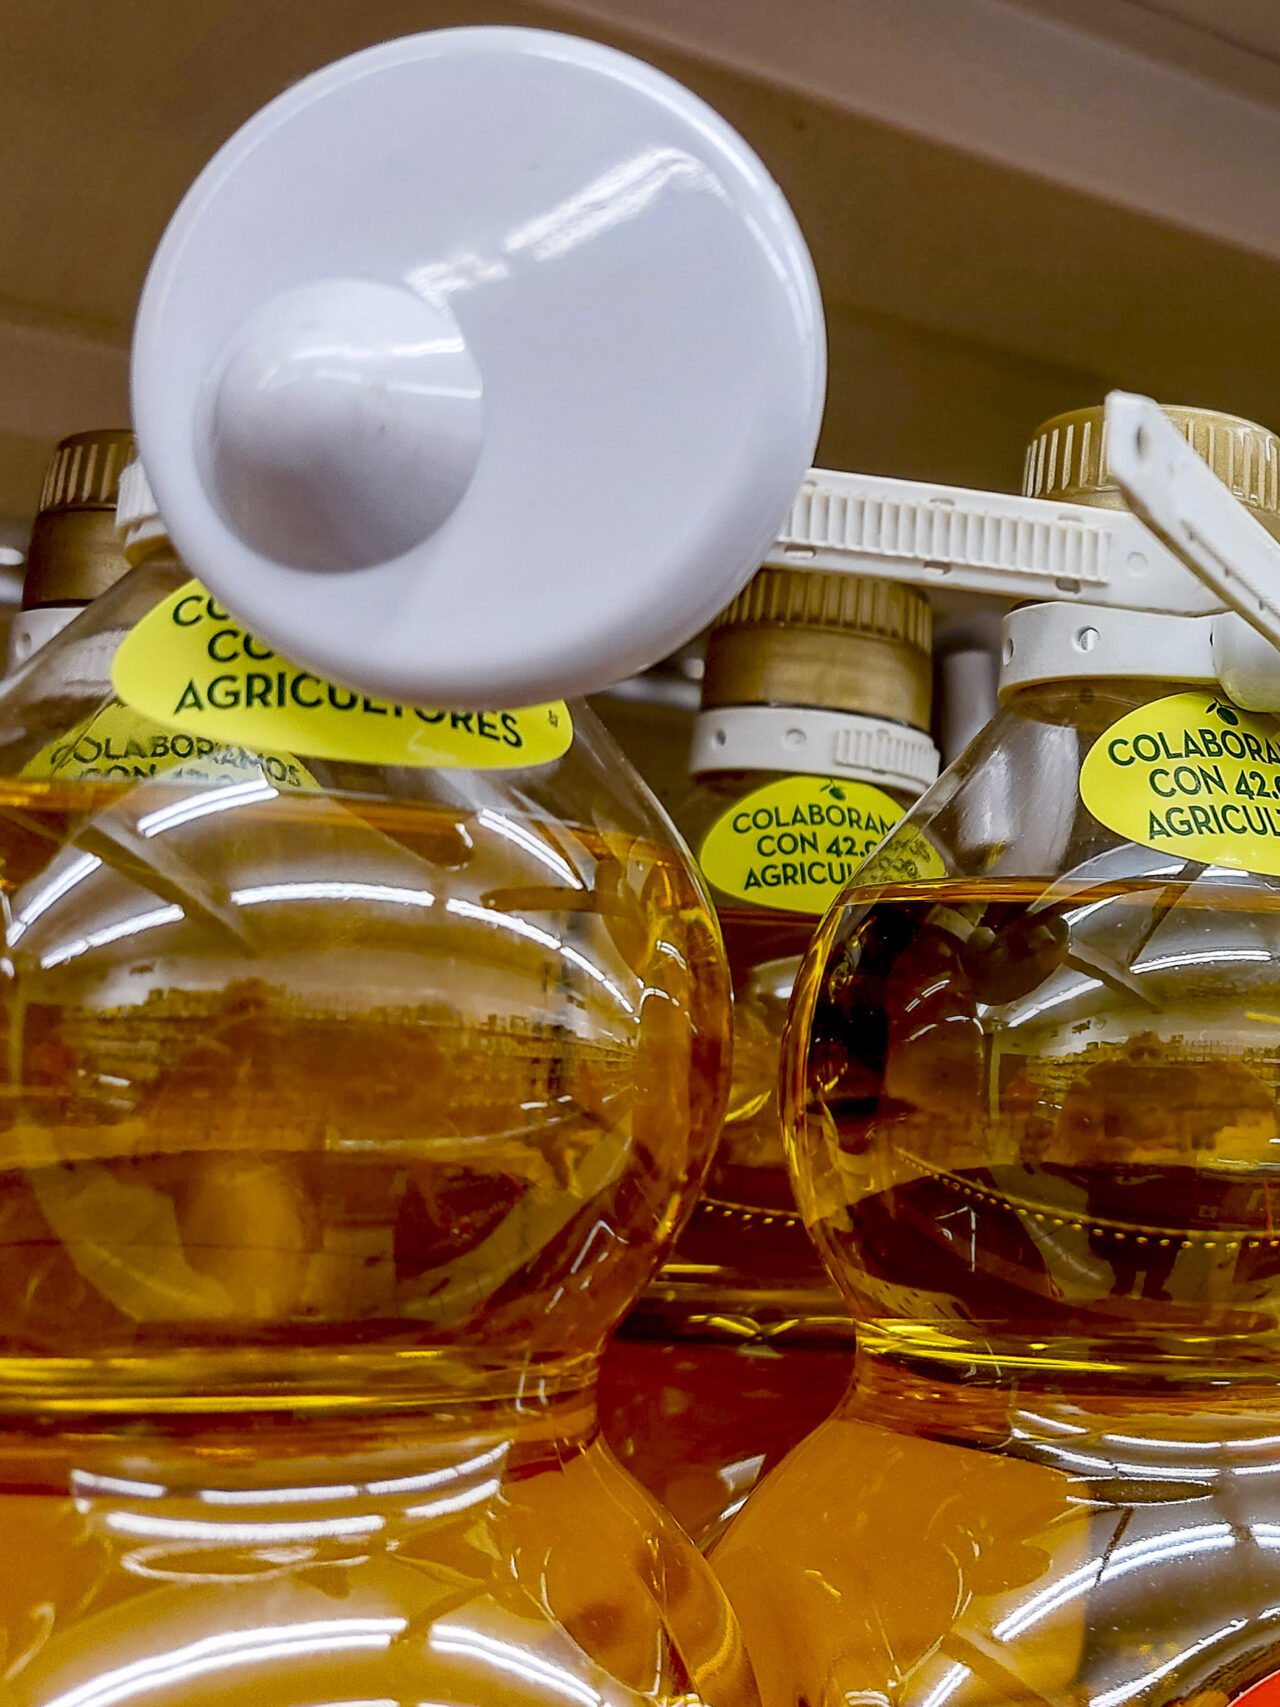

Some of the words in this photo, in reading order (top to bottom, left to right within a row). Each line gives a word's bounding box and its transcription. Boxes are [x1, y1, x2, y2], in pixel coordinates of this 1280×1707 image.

[208, 629, 275, 662] CO
[1149, 765, 1229, 798] CON
[732, 803, 896, 835] COLABORAM
[757, 832, 820, 858] CON
